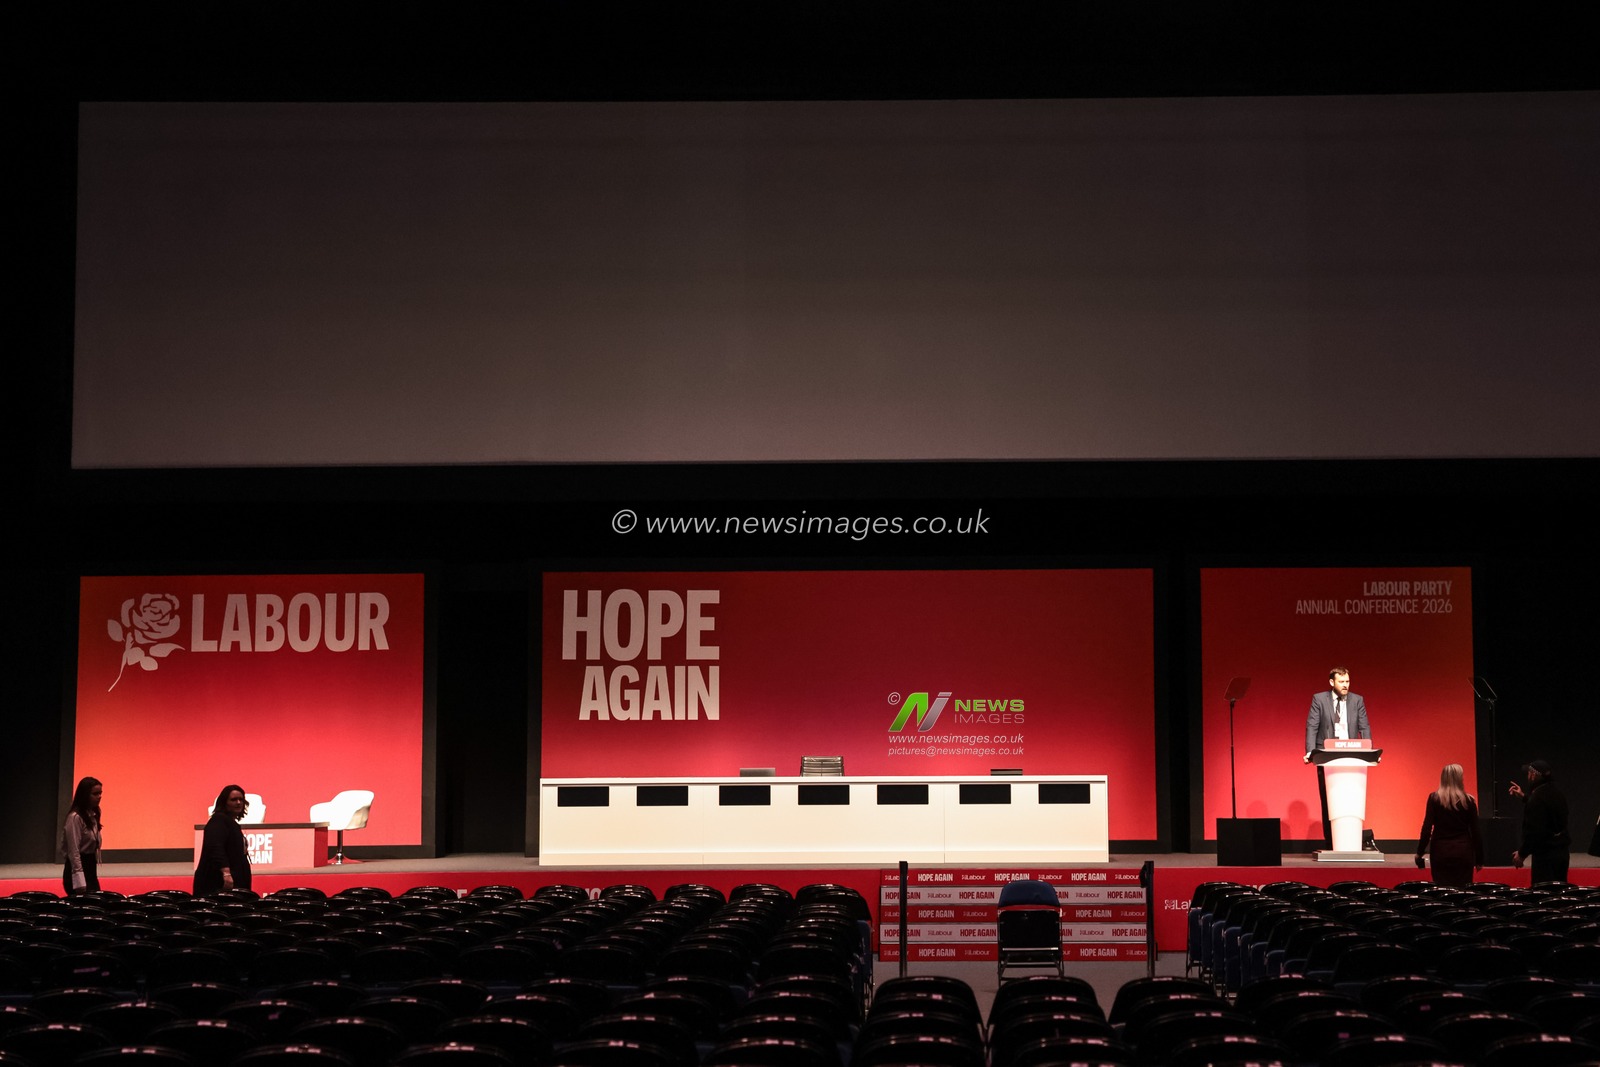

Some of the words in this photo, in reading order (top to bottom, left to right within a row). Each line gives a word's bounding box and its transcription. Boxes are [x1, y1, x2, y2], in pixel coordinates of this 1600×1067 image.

[1363, 581, 1410, 596] LABOUR
[1413, 580, 1452, 596] PARTY
[1296, 599, 1342, 615] ANNUAL
[1344, 599, 1419, 614] CONFERENCE
[1422, 598, 1453, 614] 2026
[191, 592, 390, 653] LABOUR
[562, 588, 720, 661] HOPE
[578, 665, 720, 721] AGAIN
[244, 833, 273, 851] OPE
[247, 850, 273, 865] GAIN
[918, 873, 934, 881] HOPE
[934, 873, 953, 881] AGAIN
[994, 873, 1010, 881] HOPE
[1011, 873, 1030, 881] AGAIN
[1071, 873, 1087, 881] HOPE
[1088, 873, 1107, 881] AGAIN
[906, 891, 921, 899] GAIN
[975, 891, 995, 899] AGAIN
[1107, 891, 1123, 899] HOPE
[1124, 891, 1143, 899] AGAIN
[918, 910, 935, 918] HOPE
[935, 910, 954, 918] AGAIN
[1076, 909, 1092, 917] HOPE
[1092, 909, 1112, 917] AGAIN
[906, 929, 921, 937] GAIN
[960, 929, 976, 937] HOPE
[977, 929, 996, 937] AGAIN
[1112, 929, 1128, 937] HOPE
[918, 948, 935, 957] HOPE
[936, 948, 956, 957] AGAIN
[1080, 948, 1096, 957] HOPE
[1097, 948, 1117, 957] AGAIN
